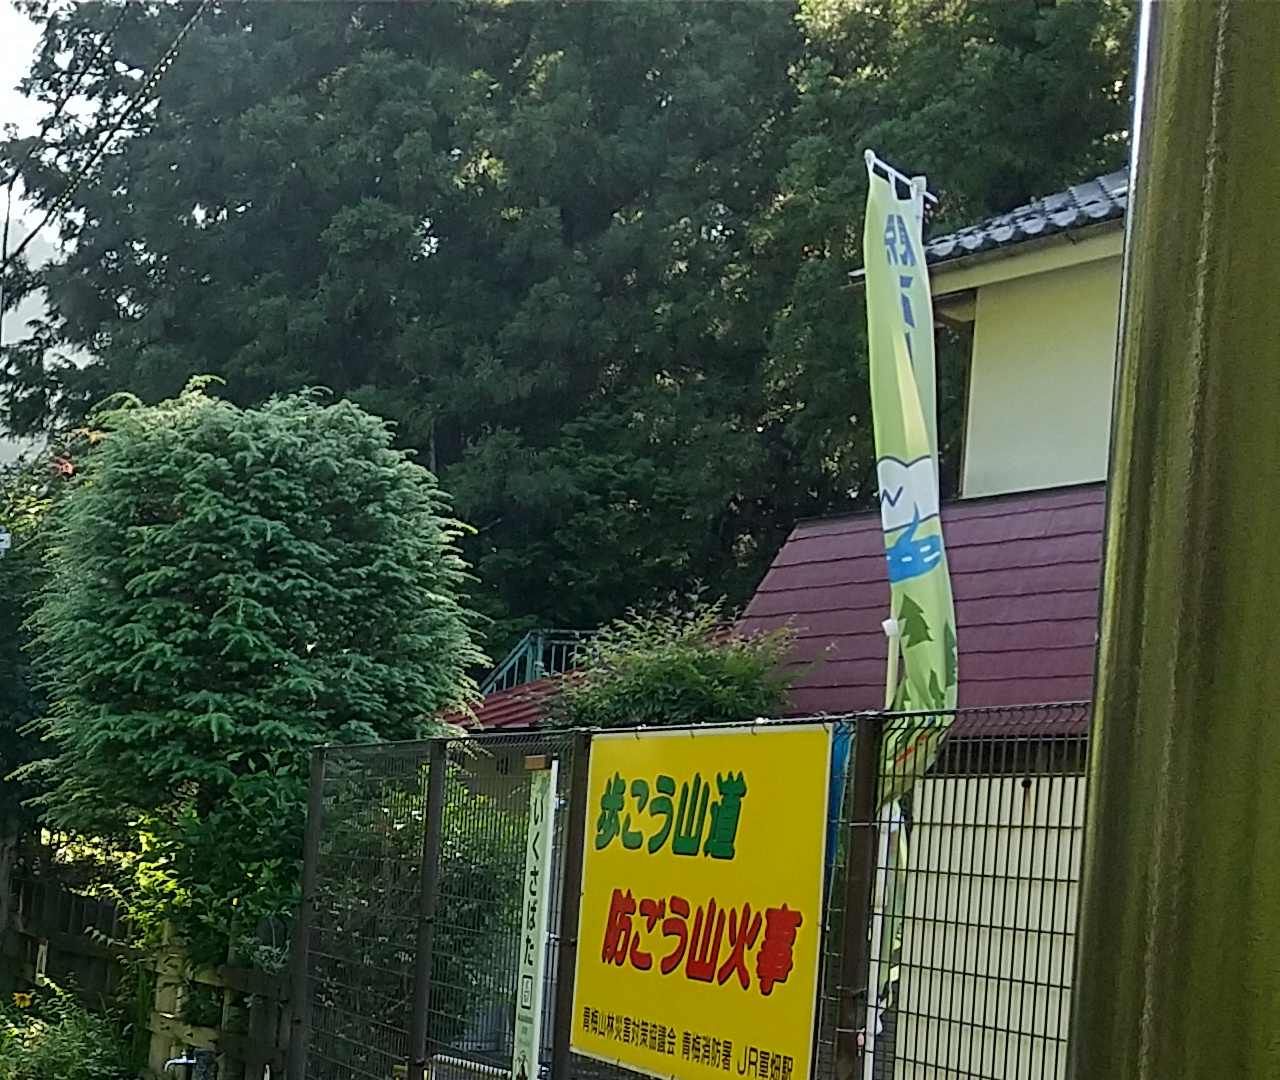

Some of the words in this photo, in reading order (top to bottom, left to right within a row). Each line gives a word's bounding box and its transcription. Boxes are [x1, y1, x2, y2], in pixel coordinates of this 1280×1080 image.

[595, 771, 747, 860] 歩こう山道
[524, 797, 544, 966] いくさばた
[601, 888, 803, 996] 防ごう山火事
[682, 1031, 732, 1072] 青梅消防署
